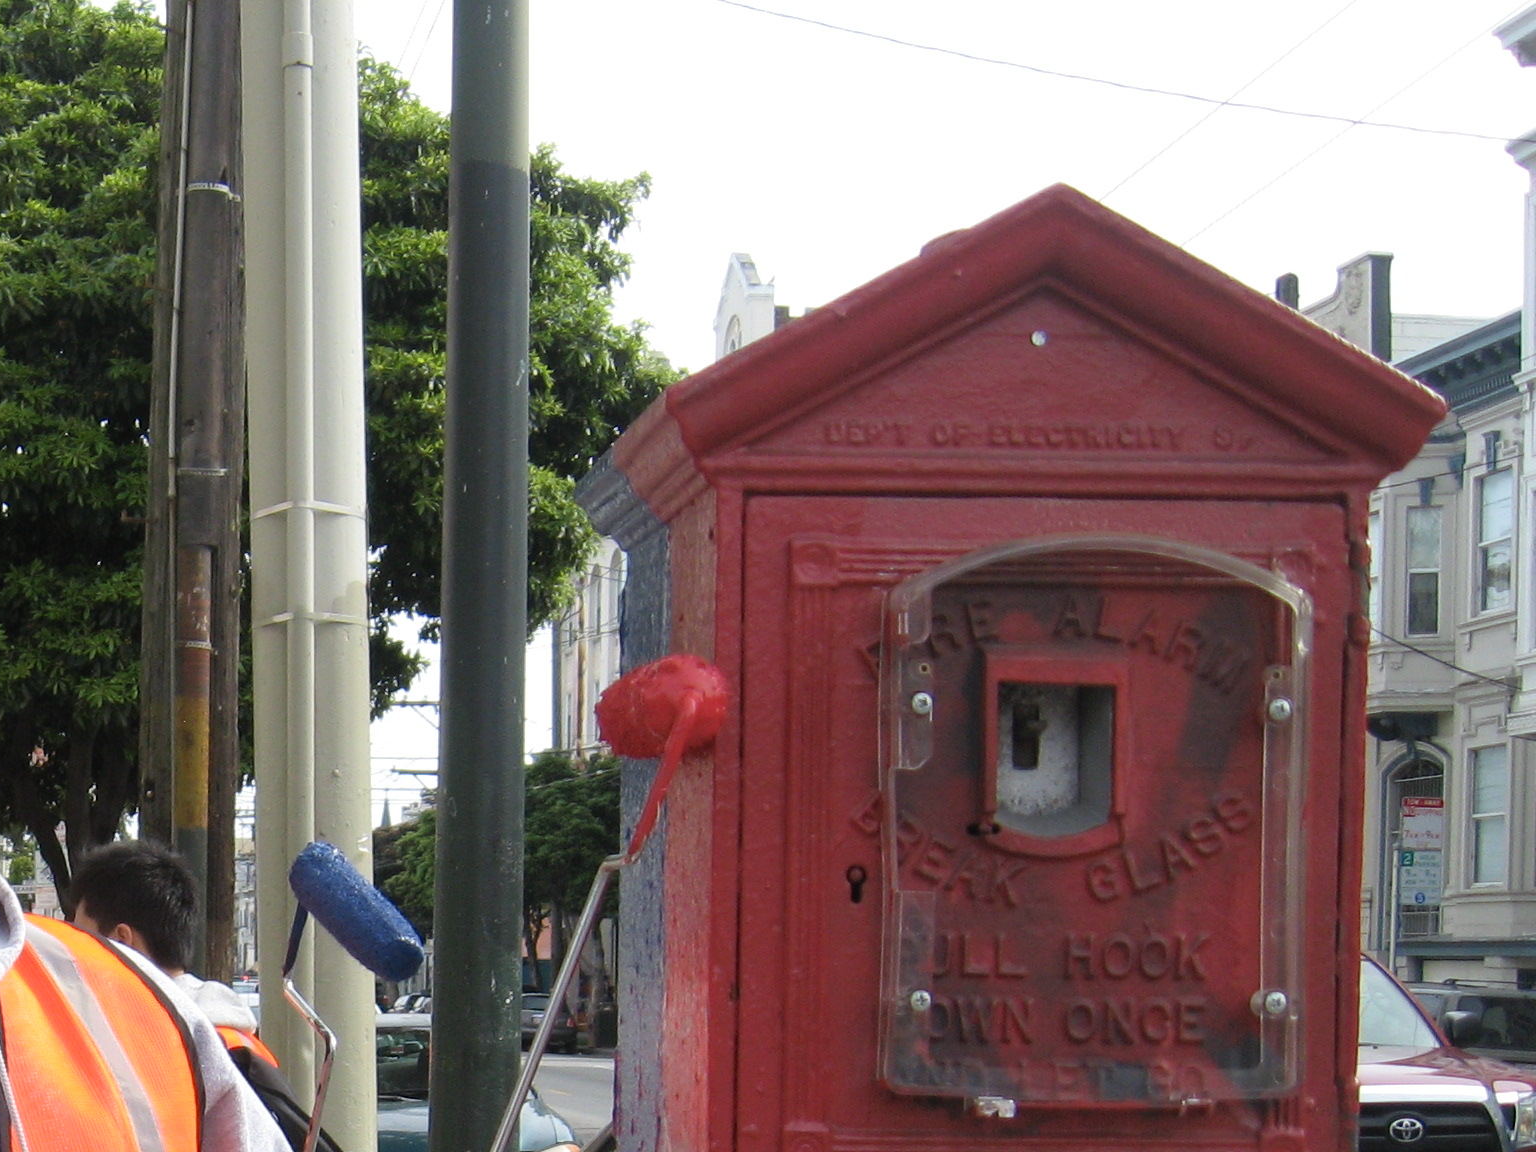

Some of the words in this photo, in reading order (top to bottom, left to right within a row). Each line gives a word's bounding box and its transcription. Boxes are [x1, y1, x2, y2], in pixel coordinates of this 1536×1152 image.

[986, 421, 1184, 450] ELECTRICITY
[860, 600, 1001, 682] FRE
[1054, 597, 1253, 697] ALARM
[850, 793, 1027, 909] BREAK
[1086, 796, 1251, 902] GLASS
[1403, 852, 1411, 865] 2
[932, 929, 1026, 980] ULL
[1064, 928, 1211, 982] HOOK
[928, 997, 1035, 1046] OWN
[1066, 997, 1210, 1046] ONCE
